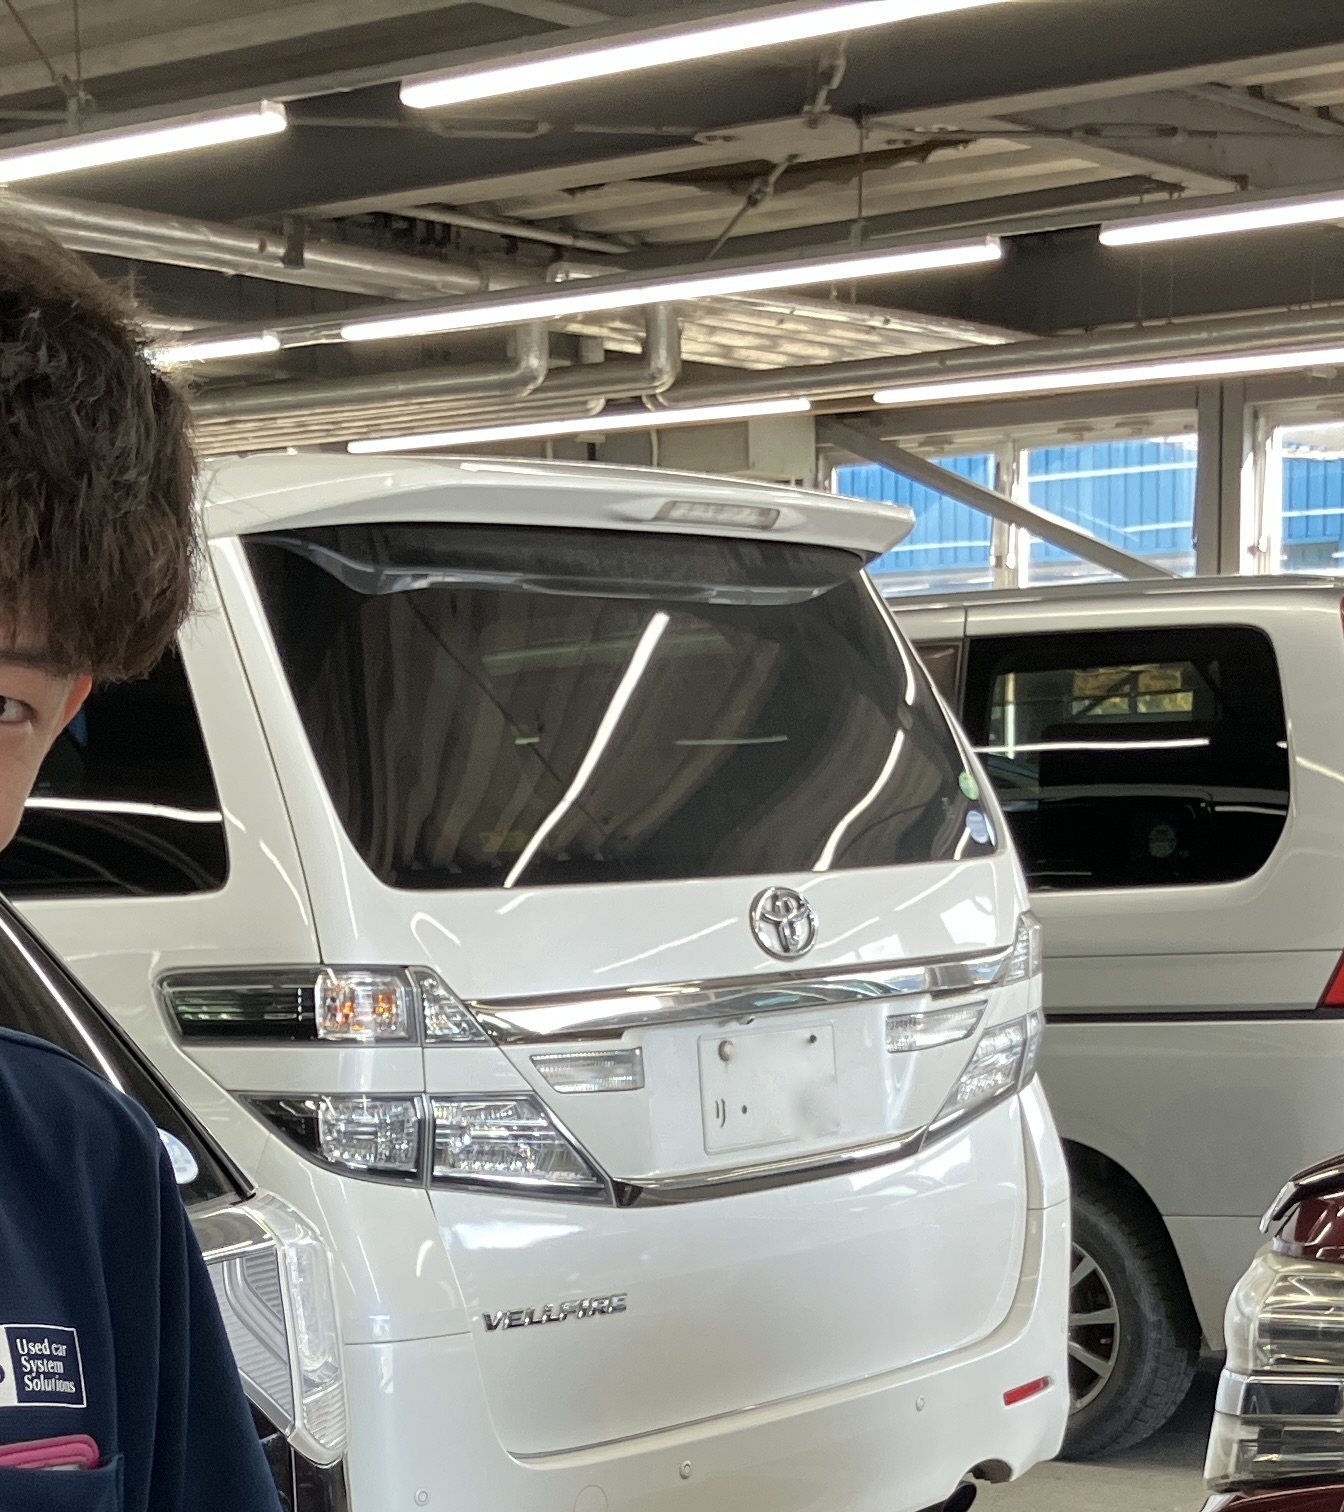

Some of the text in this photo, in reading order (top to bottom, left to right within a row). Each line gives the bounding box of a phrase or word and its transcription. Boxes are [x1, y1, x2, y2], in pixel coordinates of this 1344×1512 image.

[482, 1292, 627, 1332] VELLFIRE
[16, 1338, 67, 1357] Used car
[20, 1356, 64, 1376] System
[24, 1375, 76, 1394] Solutions
